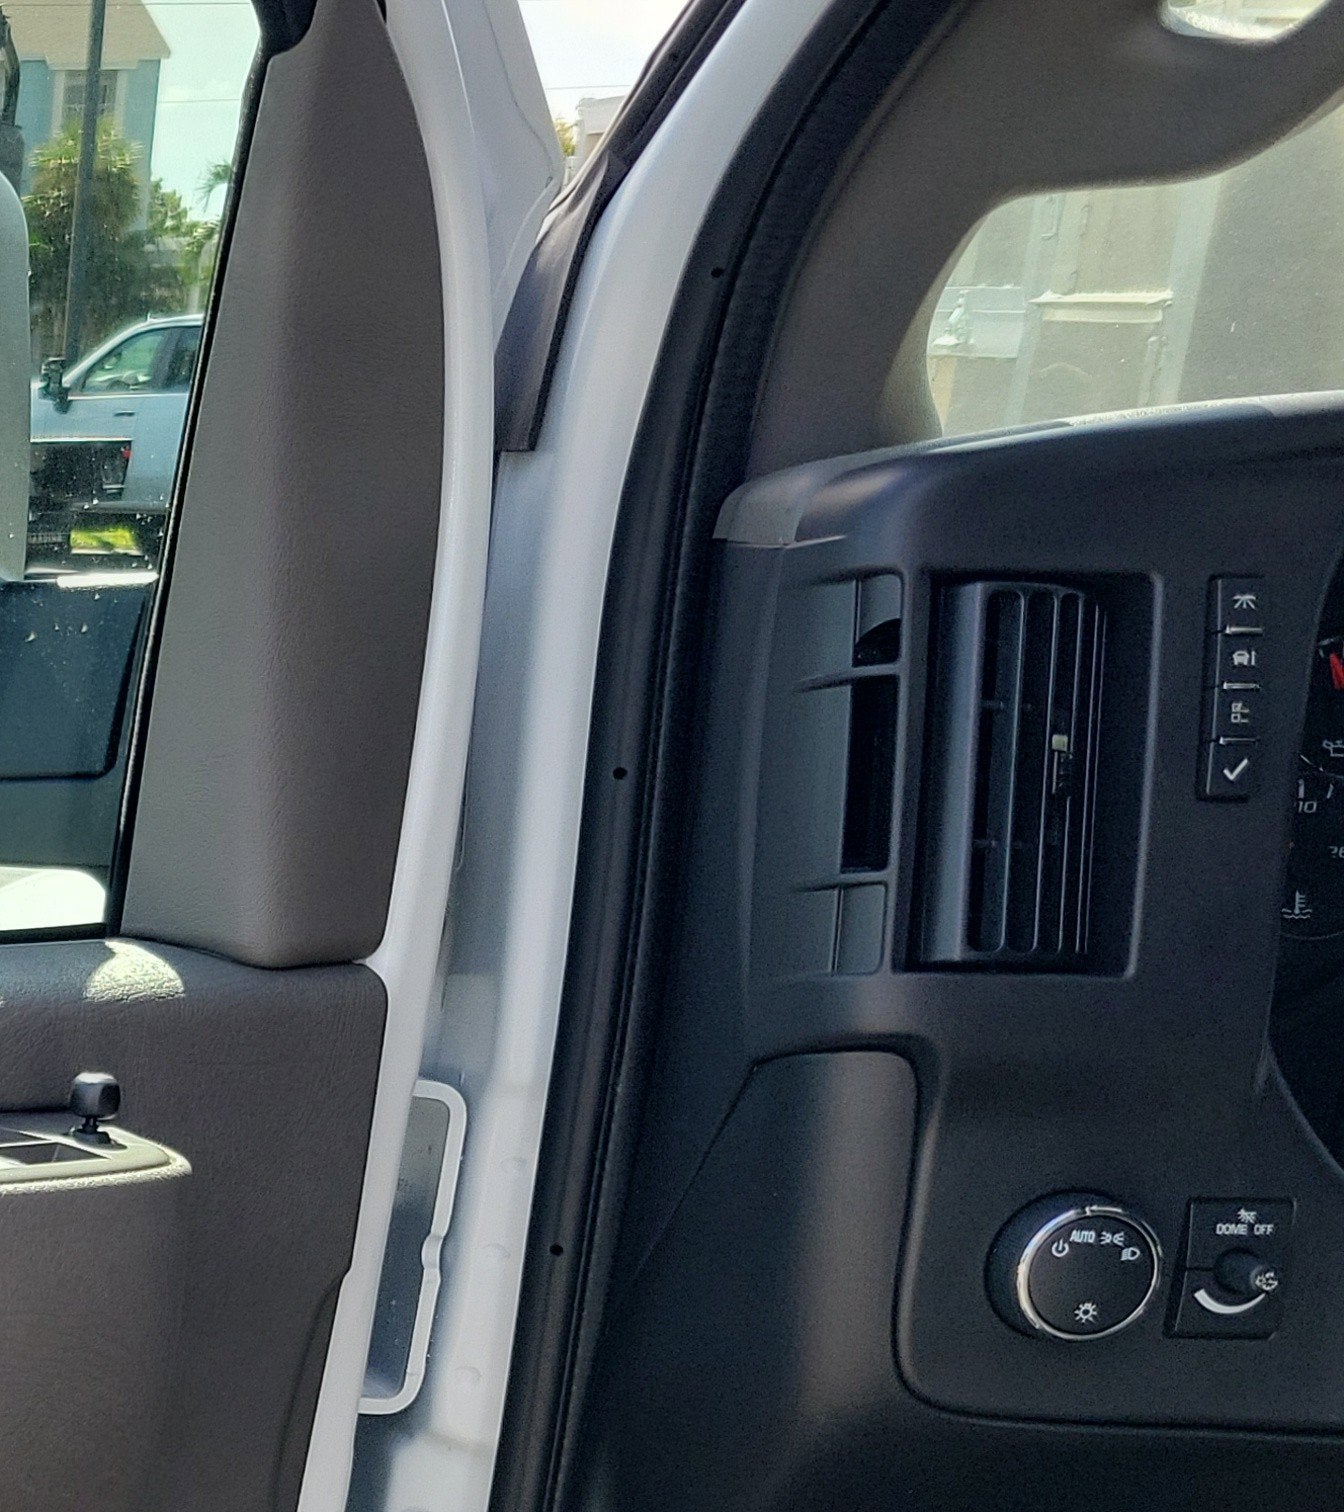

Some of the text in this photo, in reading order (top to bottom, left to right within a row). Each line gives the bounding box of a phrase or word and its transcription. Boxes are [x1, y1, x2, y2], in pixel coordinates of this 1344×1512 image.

[1070, 1229, 1096, 1244] AUTO
[1215, 1223, 1274, 1236] DOME OFF
